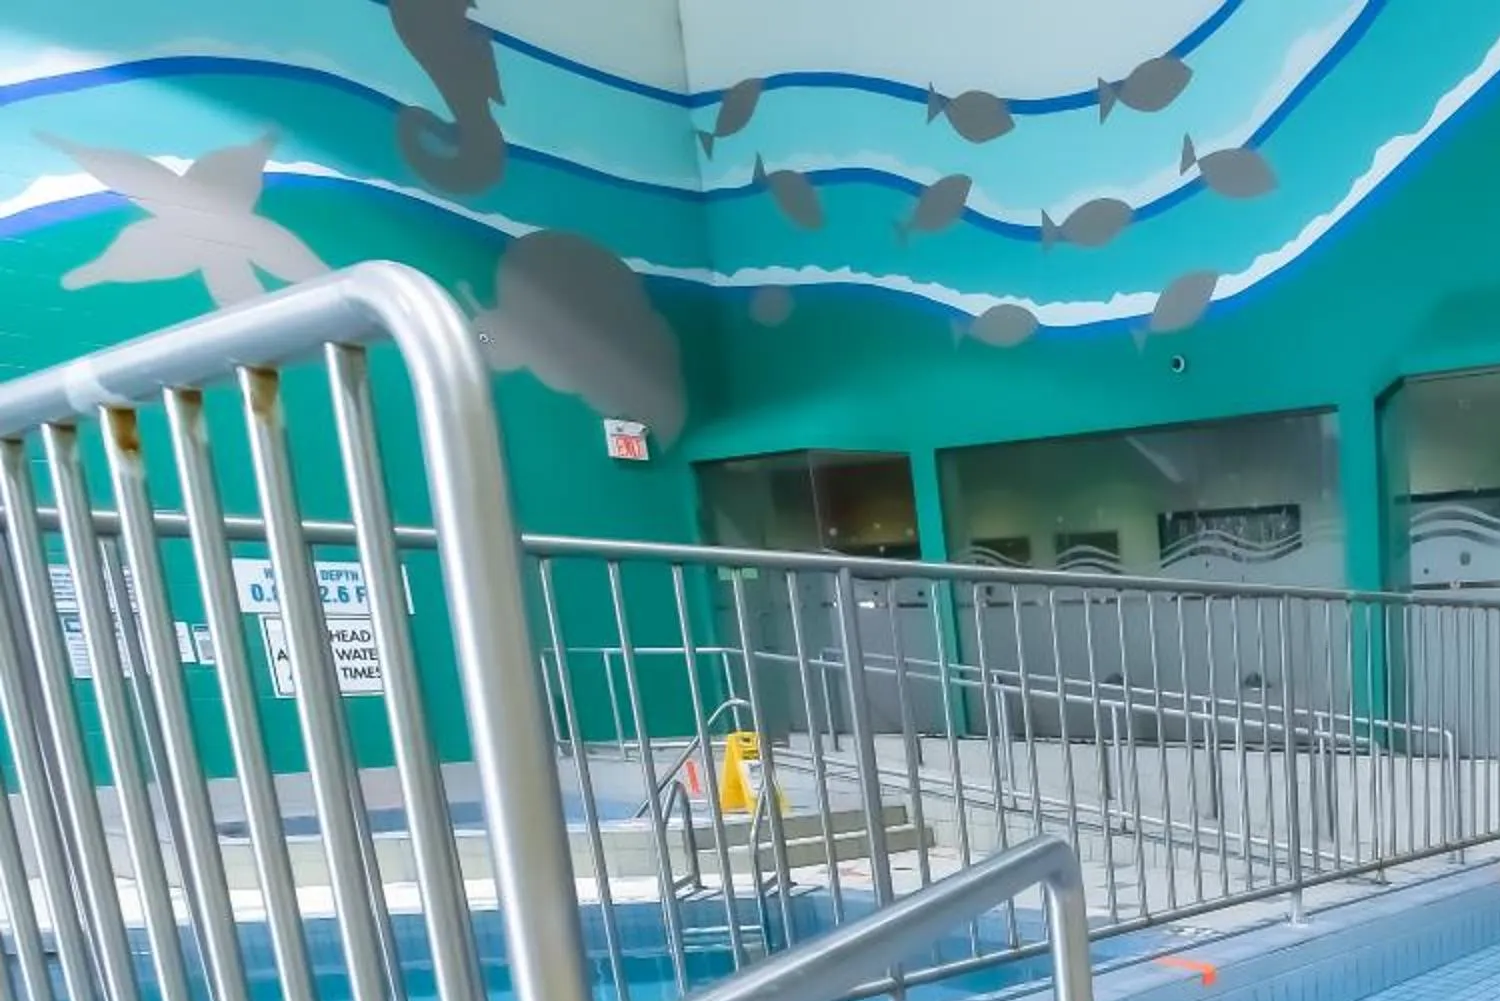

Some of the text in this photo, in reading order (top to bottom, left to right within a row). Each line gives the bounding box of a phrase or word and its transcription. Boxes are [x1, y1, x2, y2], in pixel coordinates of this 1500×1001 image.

[320, 569, 359, 581] DEPTH
[319, 585, 350, 604] 2.6
[329, 629, 371, 643] HEAD
[335, 647, 379, 661] WATE
